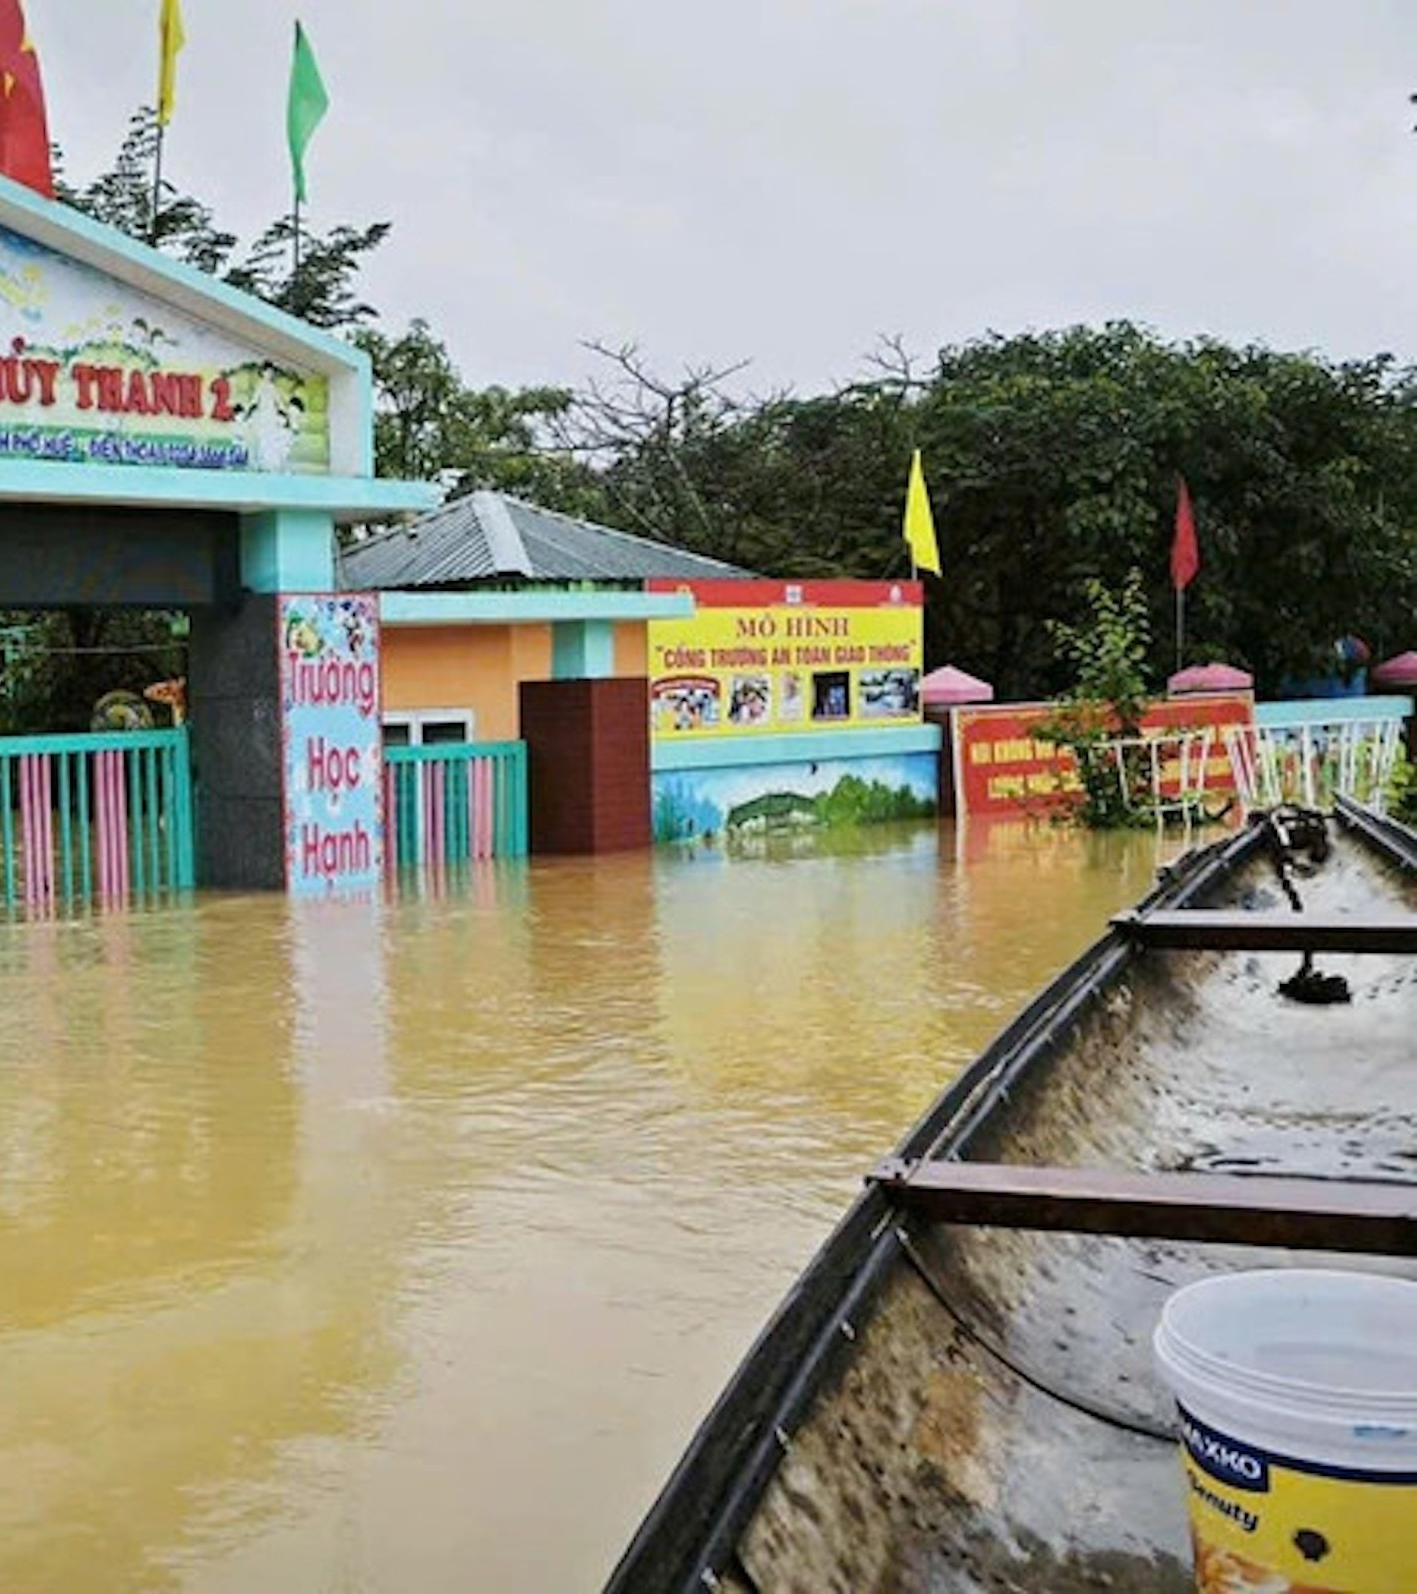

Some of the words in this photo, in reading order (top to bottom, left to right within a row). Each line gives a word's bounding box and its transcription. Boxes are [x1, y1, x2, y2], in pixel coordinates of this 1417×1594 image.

[71, 363, 204, 419] THANH
[209, 376, 236, 421] 2
[736, 613, 776, 637] MÔ
[288, 650, 375, 717] Trường
[307, 735, 360, 806] Học
[301, 818, 370, 888] Hạnh
